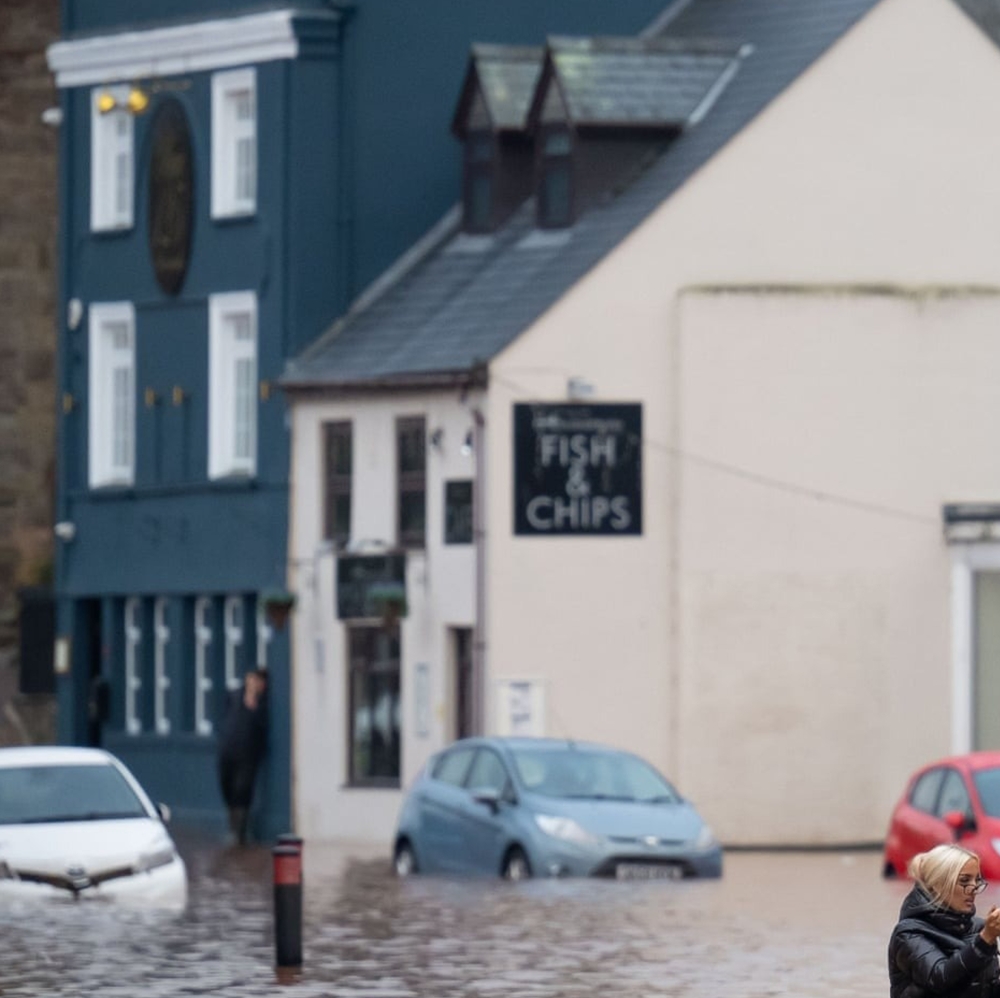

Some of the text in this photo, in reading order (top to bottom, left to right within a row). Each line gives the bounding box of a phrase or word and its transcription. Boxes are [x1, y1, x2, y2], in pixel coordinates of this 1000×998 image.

[541, 434, 616, 467] FISH
[565, 462, 590, 498] &
[526, 496, 631, 530] CHIPS
